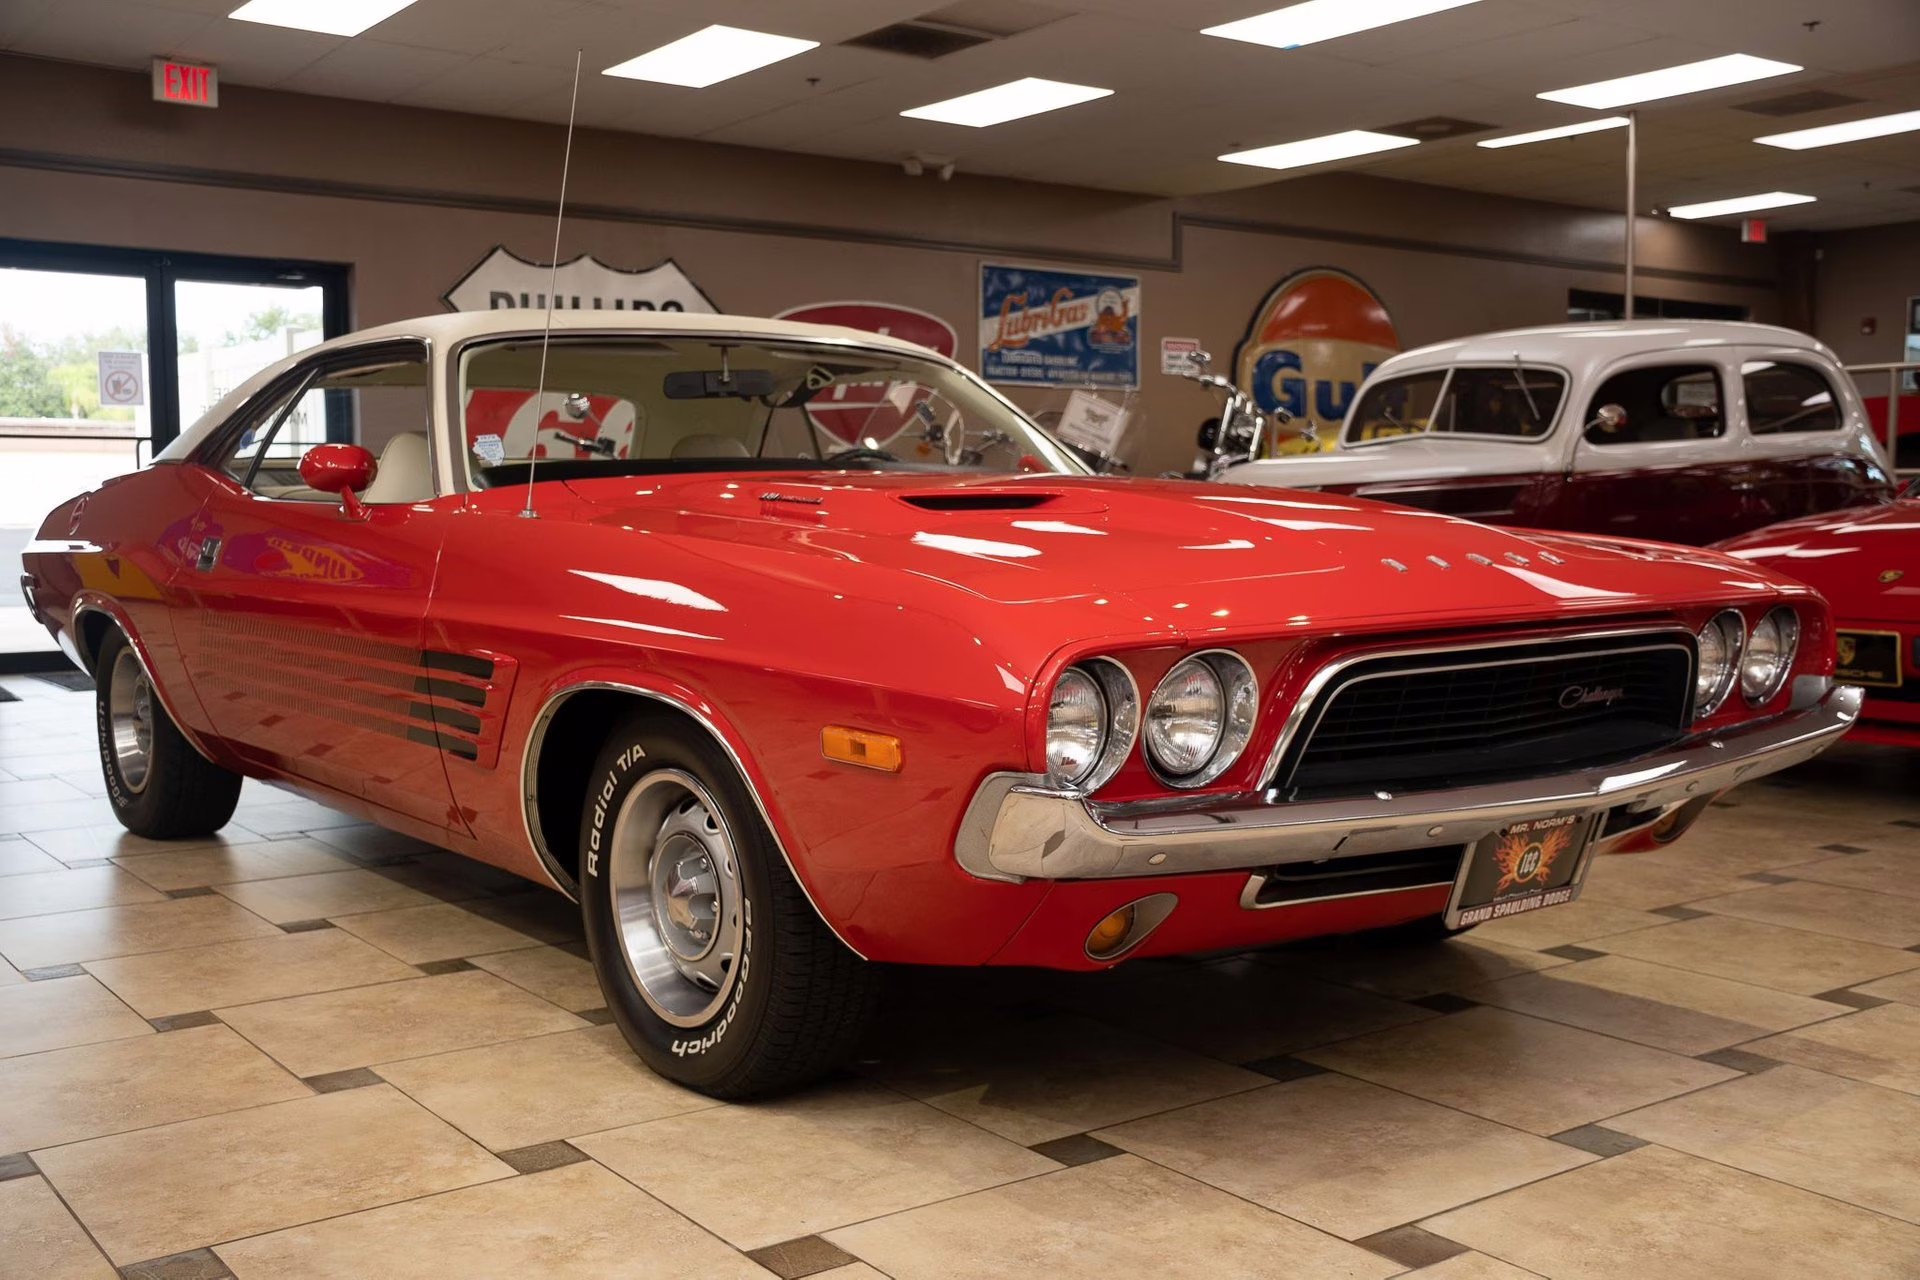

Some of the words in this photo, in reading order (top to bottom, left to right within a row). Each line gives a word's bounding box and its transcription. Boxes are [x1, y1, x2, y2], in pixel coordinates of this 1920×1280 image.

[163, 64, 210, 105] EXIT
[587, 770, 618, 877] Radial
[616, 744, 646, 771] T/A
[1509, 823, 1530, 834] MR.
[1533, 814, 1576, 830] NORM'S
[1460, 907, 1492, 926] GRAND
[1493, 896, 1543, 918] SPAULDING
[1543, 889, 1571, 907] DODGE
[671, 897, 752, 1058] BFGoodrich
